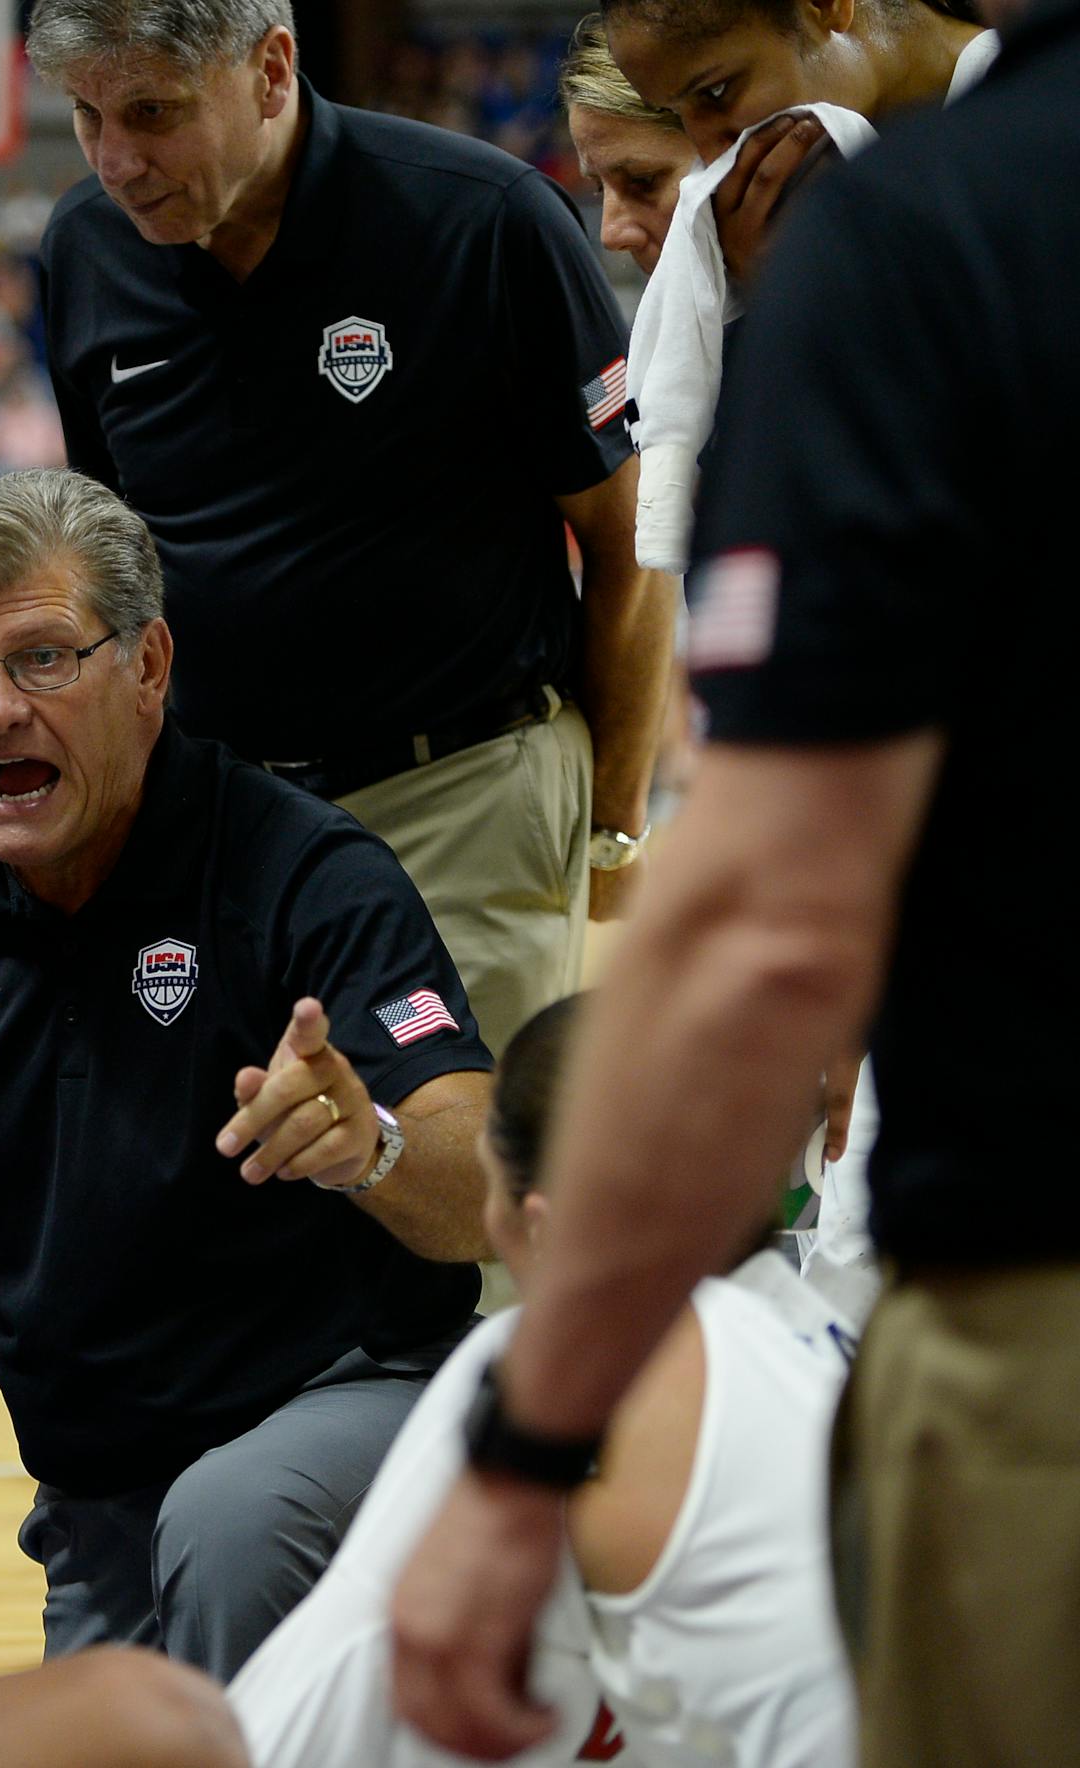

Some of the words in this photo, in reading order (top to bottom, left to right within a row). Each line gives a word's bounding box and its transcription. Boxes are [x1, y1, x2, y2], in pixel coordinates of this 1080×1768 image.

[335, 334, 375, 353] USA
[146, 952, 187, 974] USA
[135, 977, 196, 989] BASKETBALL
